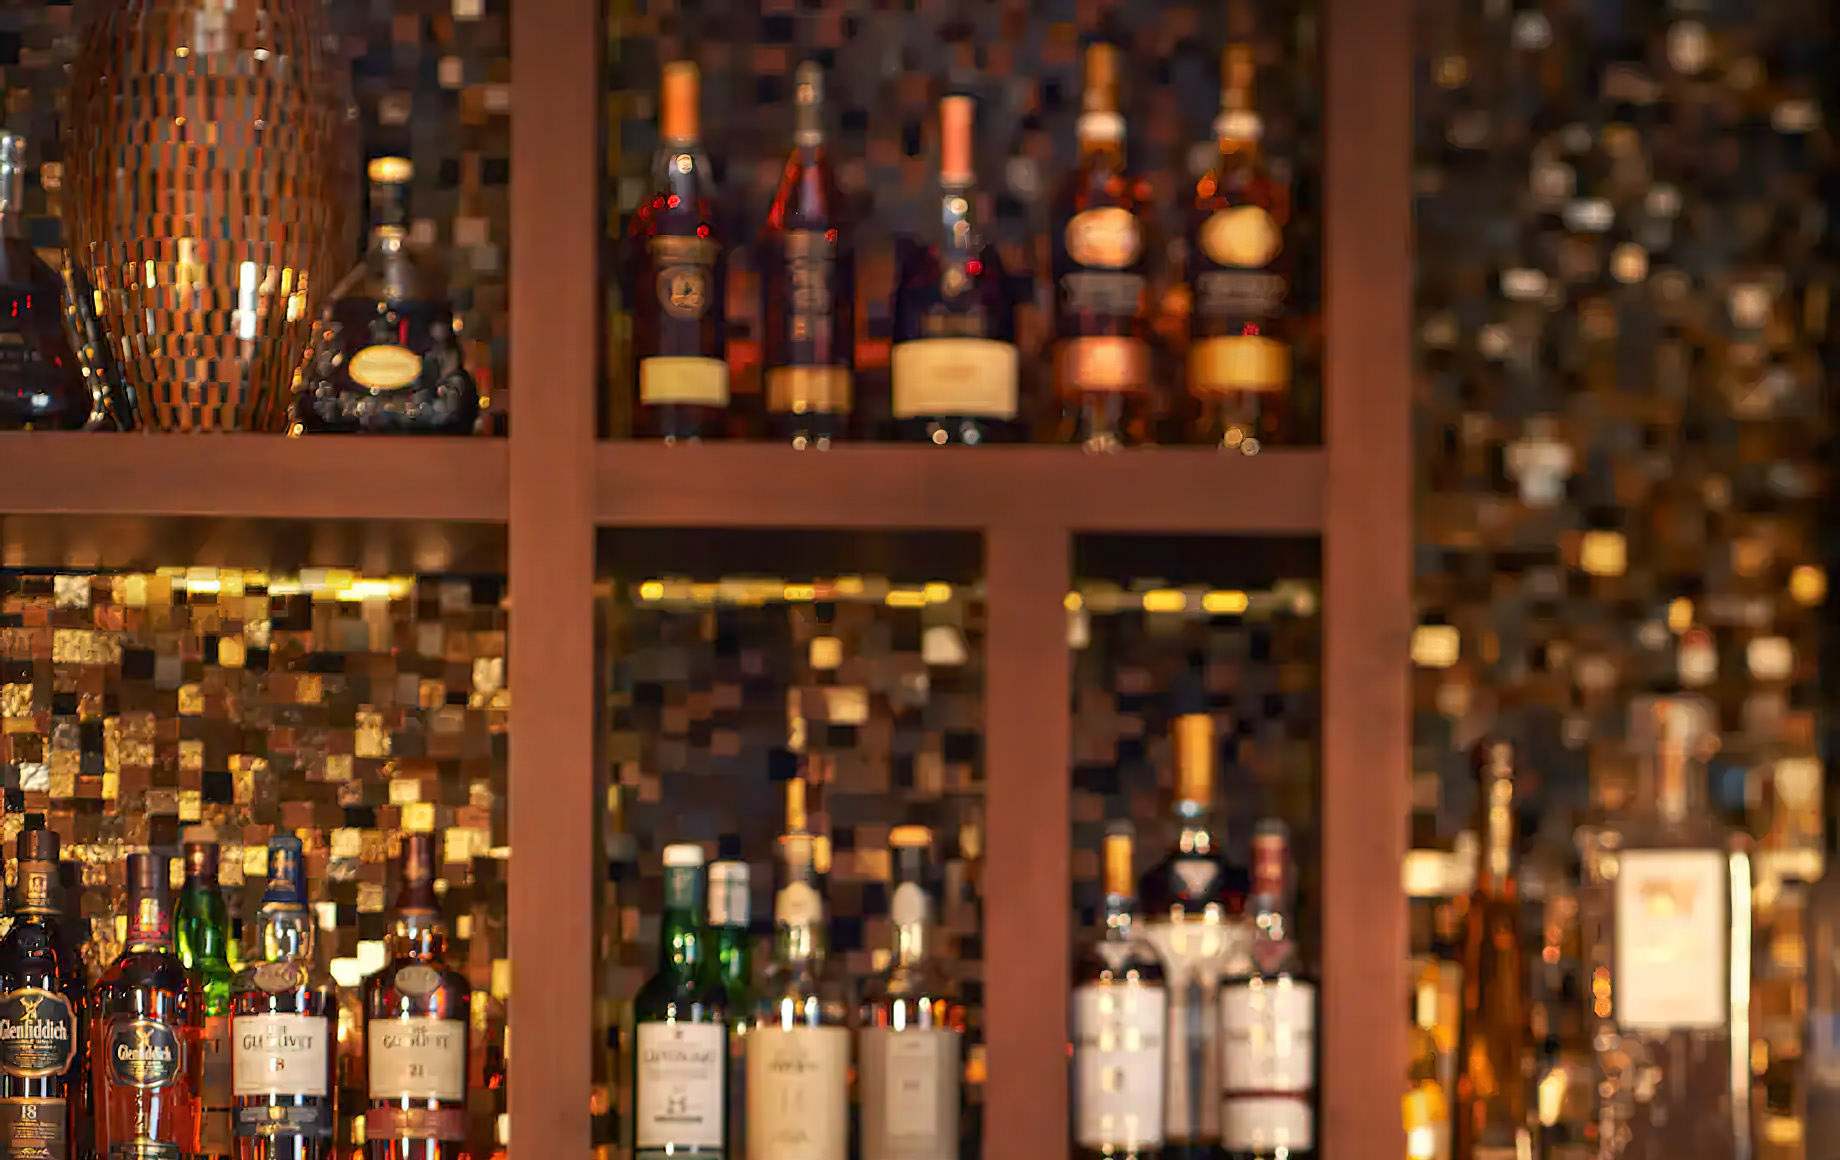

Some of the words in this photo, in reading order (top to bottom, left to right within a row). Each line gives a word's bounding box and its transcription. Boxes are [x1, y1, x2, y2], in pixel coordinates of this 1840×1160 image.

[0, 1018, 68, 1041] Glenfiddich
[117, 1043, 173, 1062] Glenddich
[21, 1103, 37, 1120] 18
